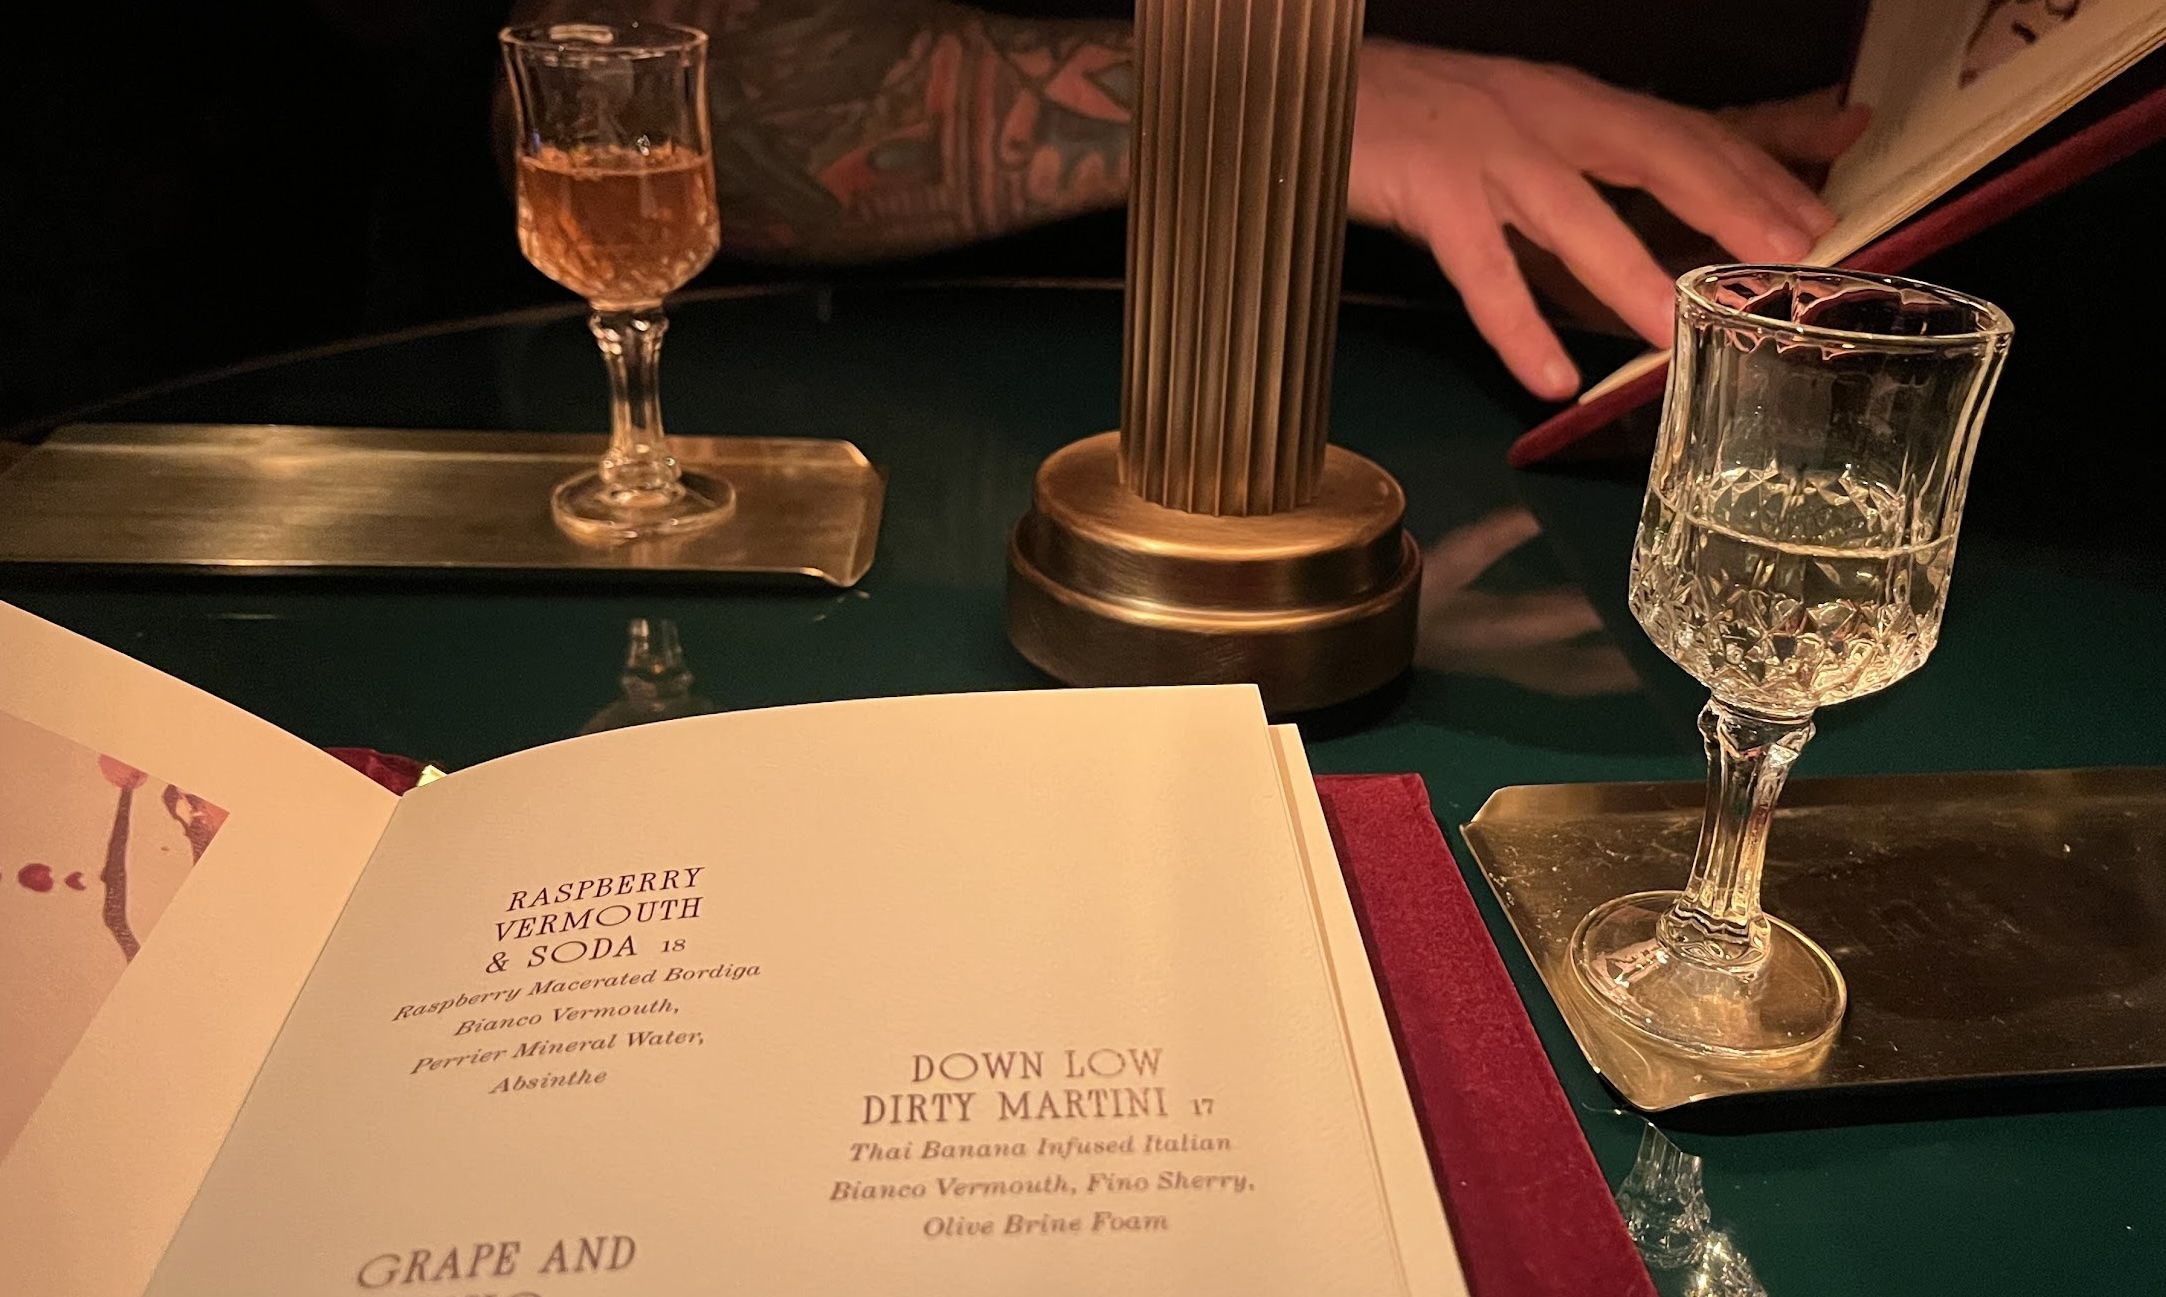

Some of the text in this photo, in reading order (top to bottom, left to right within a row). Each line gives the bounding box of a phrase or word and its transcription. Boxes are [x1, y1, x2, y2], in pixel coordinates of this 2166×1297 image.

[506, 867, 705, 912] RASPBERRY
[495, 896, 704, 942] VERMOUTH
[485, 935, 686, 974] & SODA 18
[392, 963, 761, 1021] Raspberry Macerated Bordiga
[454, 998, 680, 1037] Bianco Vermouth,
[409, 1029, 705, 1075] Perrier Mineral Water,
[912, 1047, 1163, 1083] DOWN LOW
[488, 1069, 608, 1094] Absinthe
[862, 1086, 1214, 1126] DIRTY MARTINI 17
[849, 1133, 1232, 1162] Thai Banana Infused Italian
[829, 1179, 926, 1201] Bianco
[936, 1174, 1078, 1198] Vermouth,
[1087, 1172, 1149, 1194] Fino
[923, 1210, 1168, 1237] Olive Brine Foam
[357, 1235, 638, 1291] GRAPE AND
